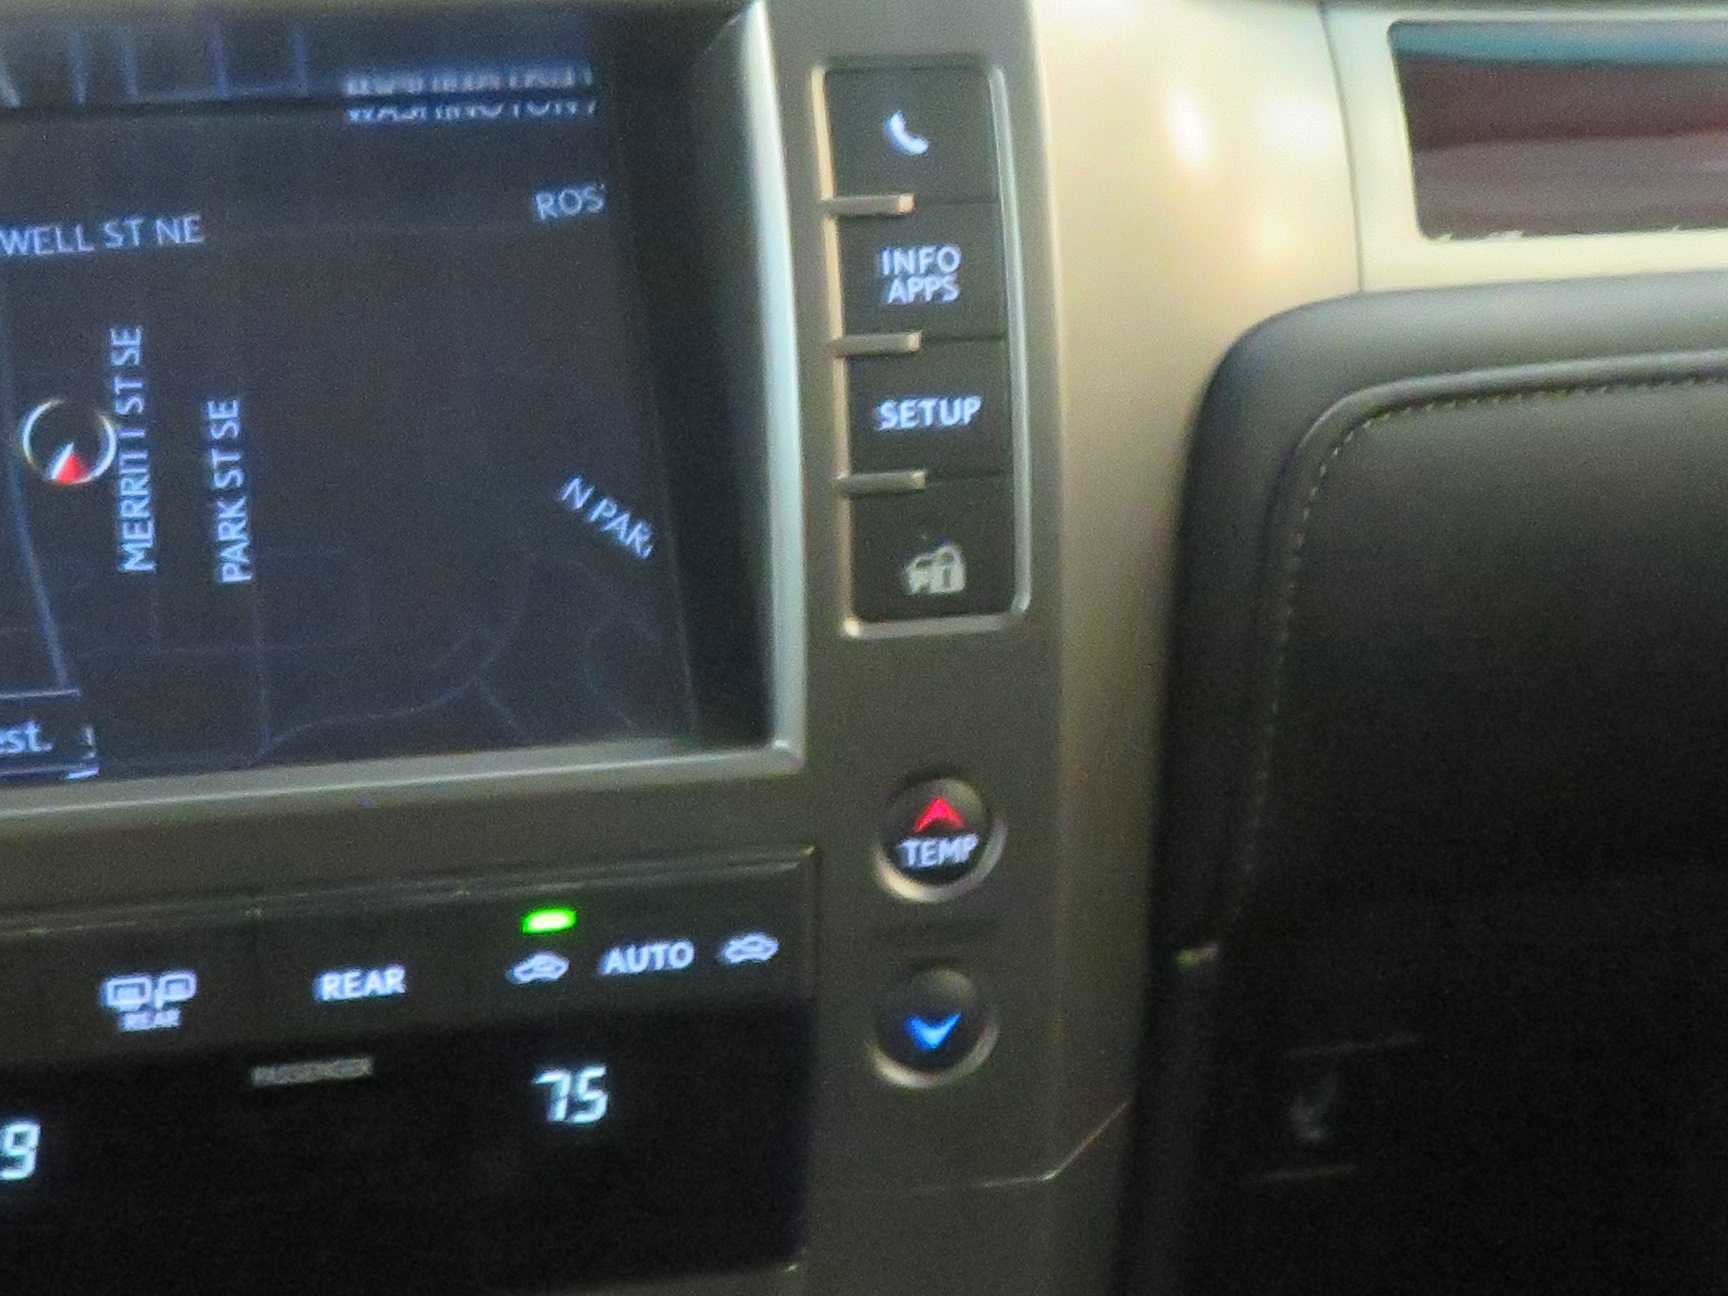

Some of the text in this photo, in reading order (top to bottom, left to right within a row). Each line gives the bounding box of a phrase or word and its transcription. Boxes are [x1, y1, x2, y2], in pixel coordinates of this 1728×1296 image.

[535, 184, 606, 219] ROS
[103, 217, 143, 248] ST
[155, 214, 204, 245] NE
[881, 245, 961, 275] INFO
[885, 273, 960, 304] APPS
[110, 326, 142, 366] SE
[113, 375, 144, 415] ST
[876, 395, 981, 430] SETUP
[207, 399, 253, 583] PARK ST SE
[561, 476, 595, 510] N
[899, 834, 980, 869] TEMP
[600, 940, 696, 976] AUTO
[314, 966, 408, 1002] REAR
[533, 1066, 610, 1124] 75
